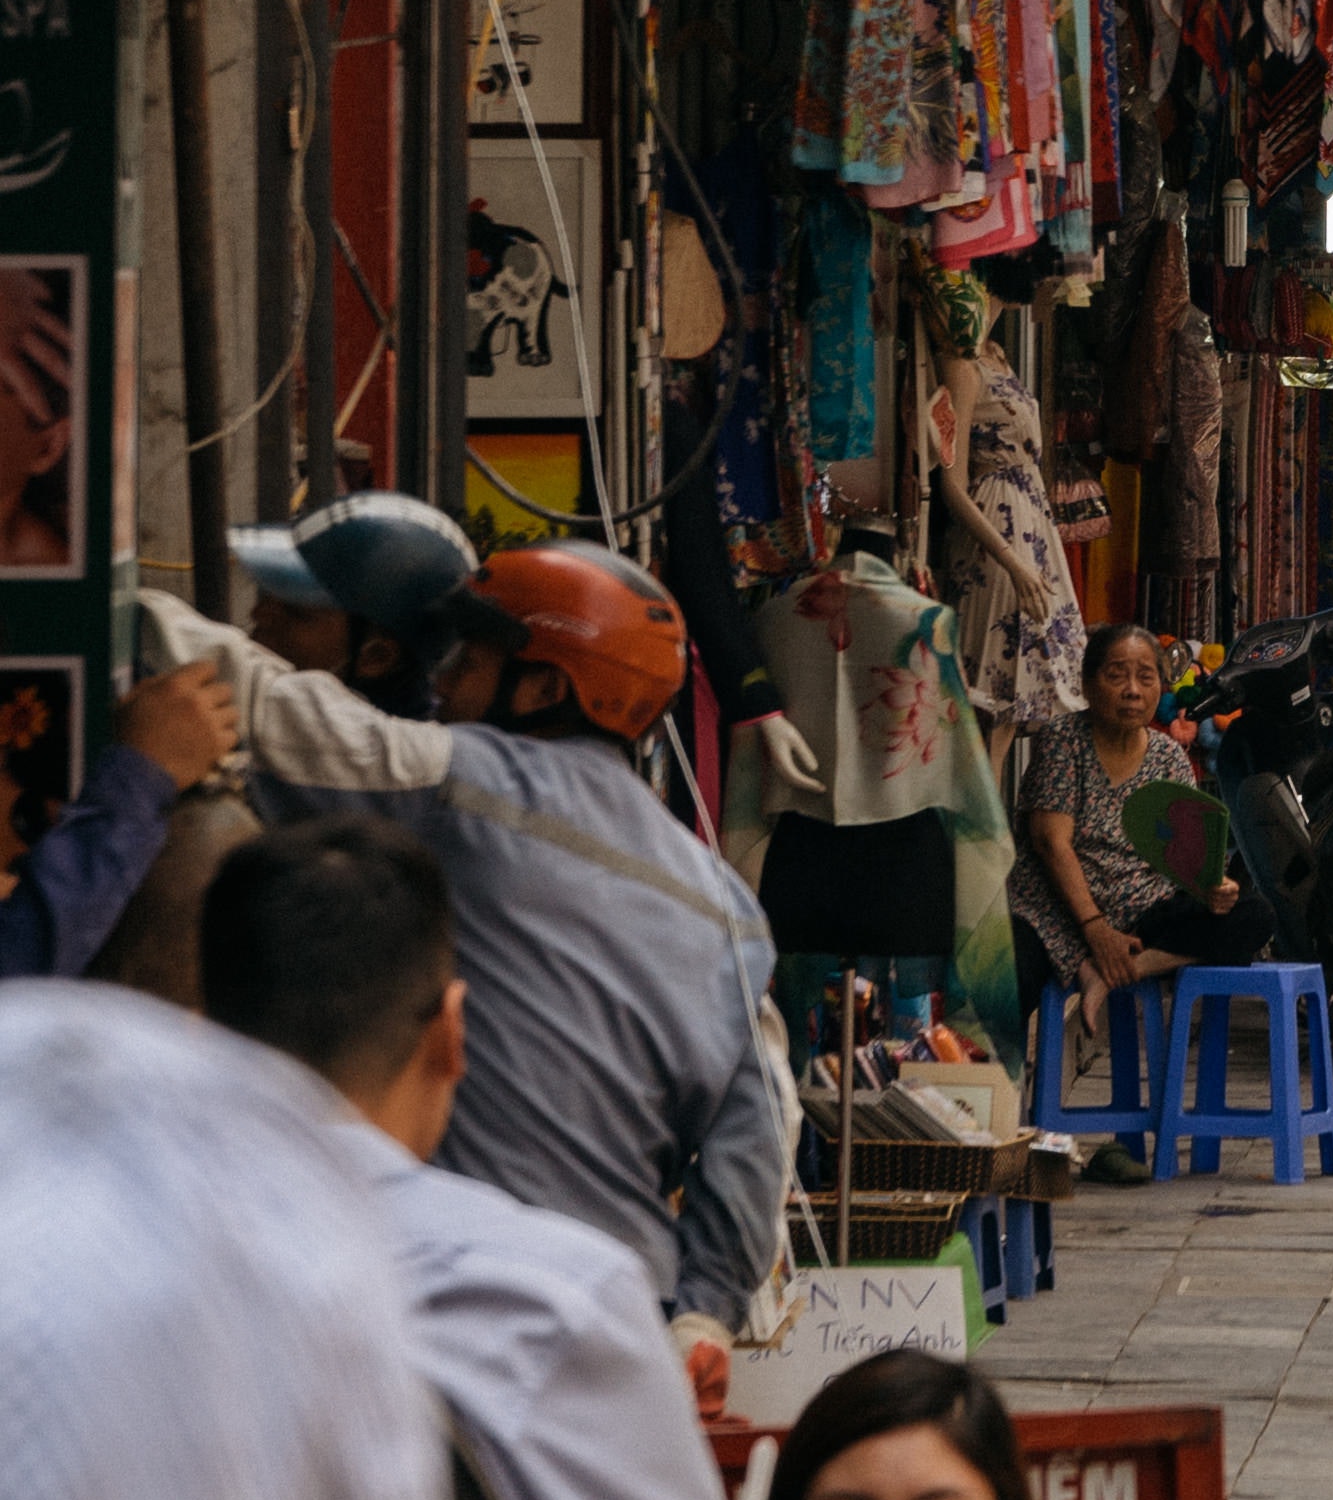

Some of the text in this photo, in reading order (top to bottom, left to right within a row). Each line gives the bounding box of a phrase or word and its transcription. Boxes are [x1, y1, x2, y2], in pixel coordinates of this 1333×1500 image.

[861, 1276, 938, 1311] NV
[815, 1318, 893, 1354] Tiếng
[899, 1319, 963, 1352] Anh
